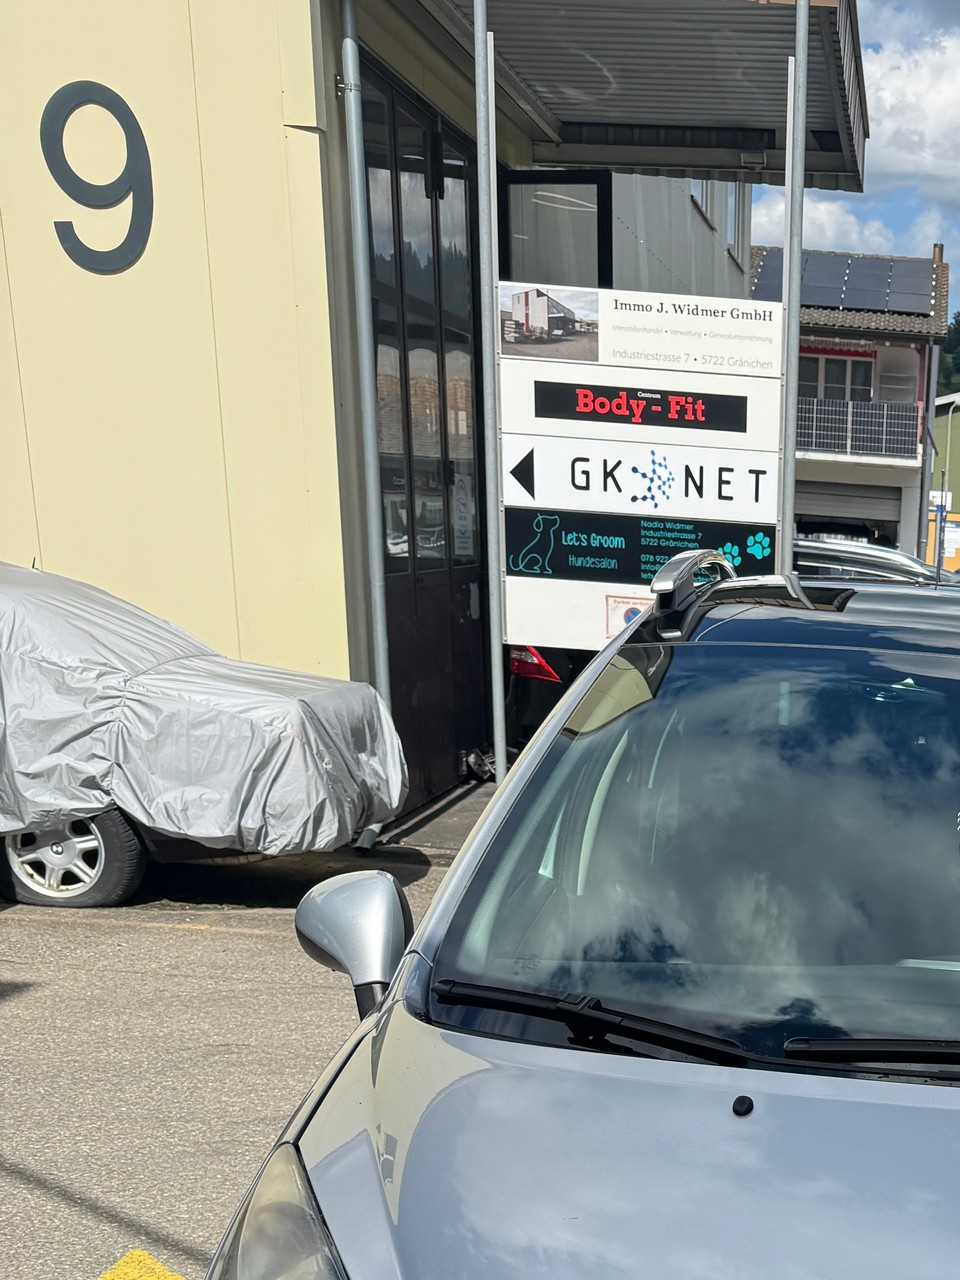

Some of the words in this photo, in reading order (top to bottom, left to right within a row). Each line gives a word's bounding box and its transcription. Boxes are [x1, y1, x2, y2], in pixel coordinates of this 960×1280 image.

[39, 79, 154, 276] 9
[613, 299, 653, 313] Immo
[656, 302, 668, 314] J.
[671, 303, 727, 318] Widmer
[730, 307, 773, 321] GmbH
[612, 348, 681, 363] Industriestrasse
[683, 353, 690, 363] 7
[701, 354, 725, 367] 5722
[727, 356, 773, 370] Gränichen
[637, 391, 661, 399] Centrum
[575, 388, 646, 423] Body
[667, 395, 706, 422] Fit
[640, 520, 664, 529] Nadia
[665, 521, 694, 531] Widmer
[640, 529, 696, 540] Industriestrasse
[697, 532, 703, 540] 7
[561, 530, 588, 547] Let's
[590, 532, 626, 550] Groom
[640, 538, 659, 546] 5722
[568, 554, 618, 570] Hundesalon
